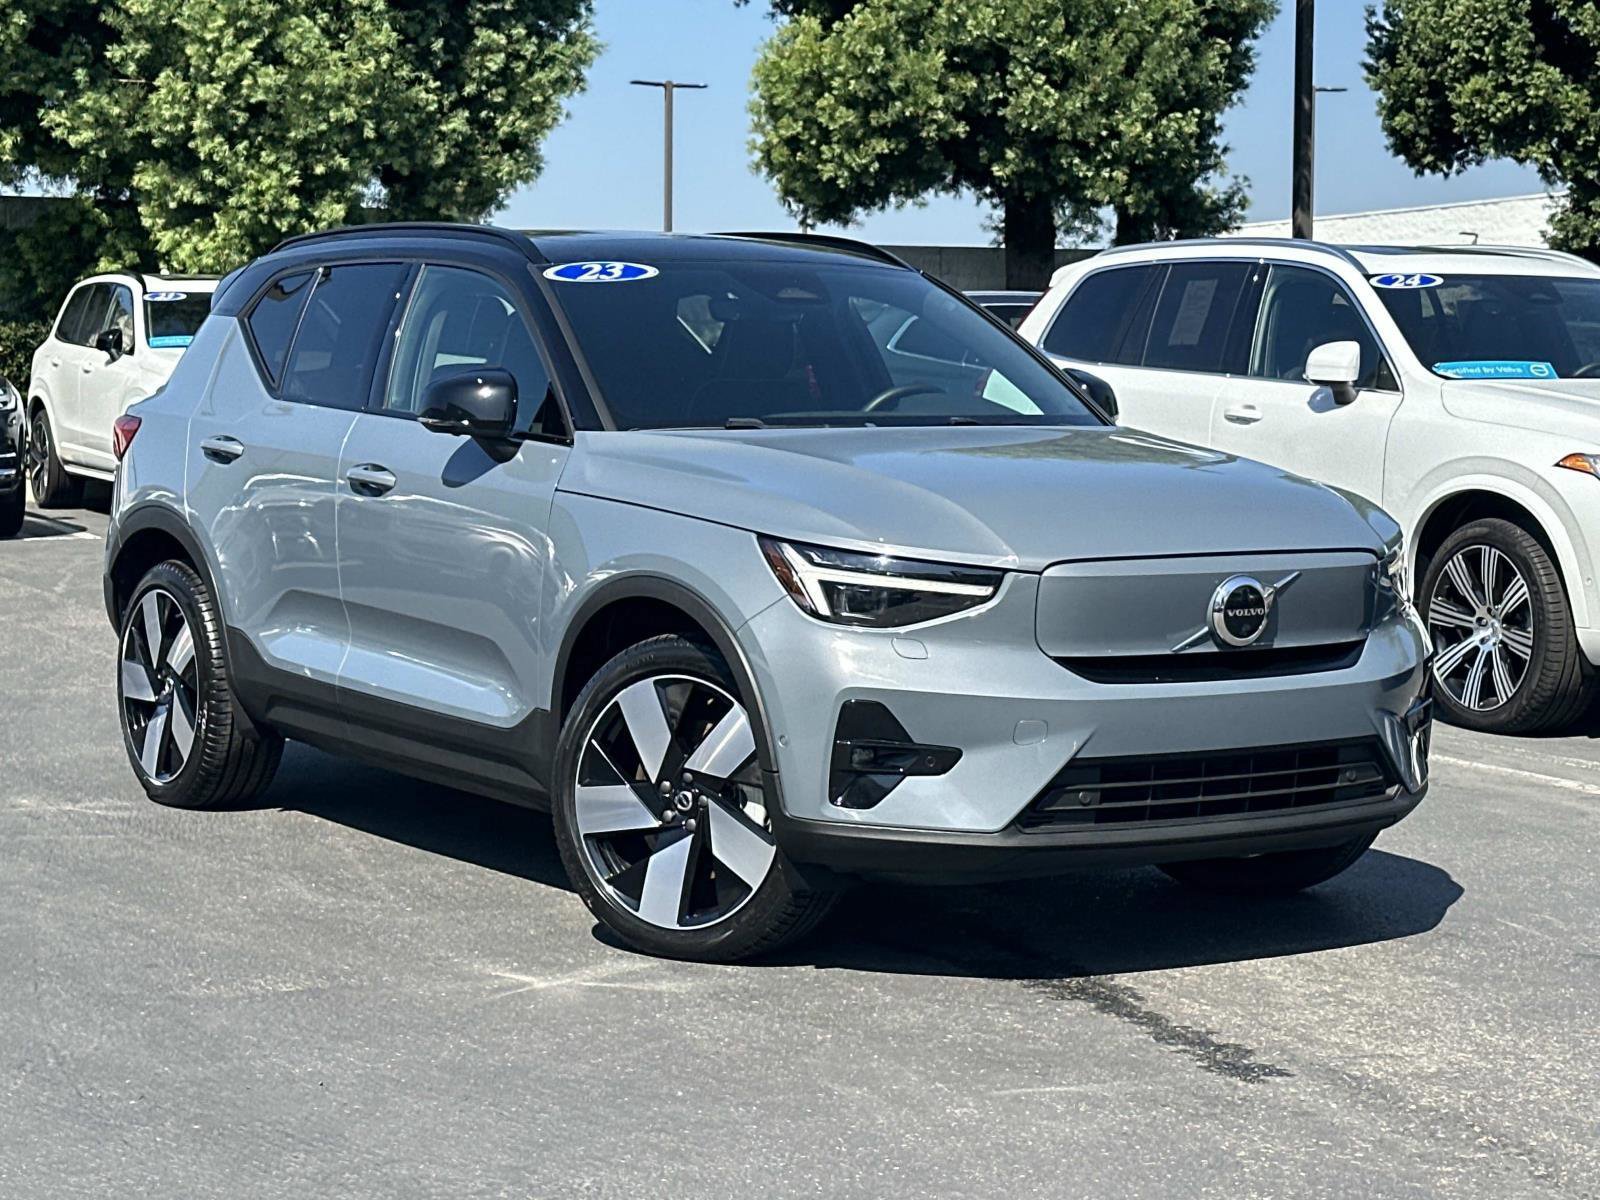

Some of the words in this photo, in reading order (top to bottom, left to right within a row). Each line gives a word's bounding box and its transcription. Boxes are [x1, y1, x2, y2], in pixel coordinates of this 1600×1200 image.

[576, 263, 625, 280] 23
[1390, 273, 1421, 287] 24
[1227, 608, 1265, 617] VOLVO
